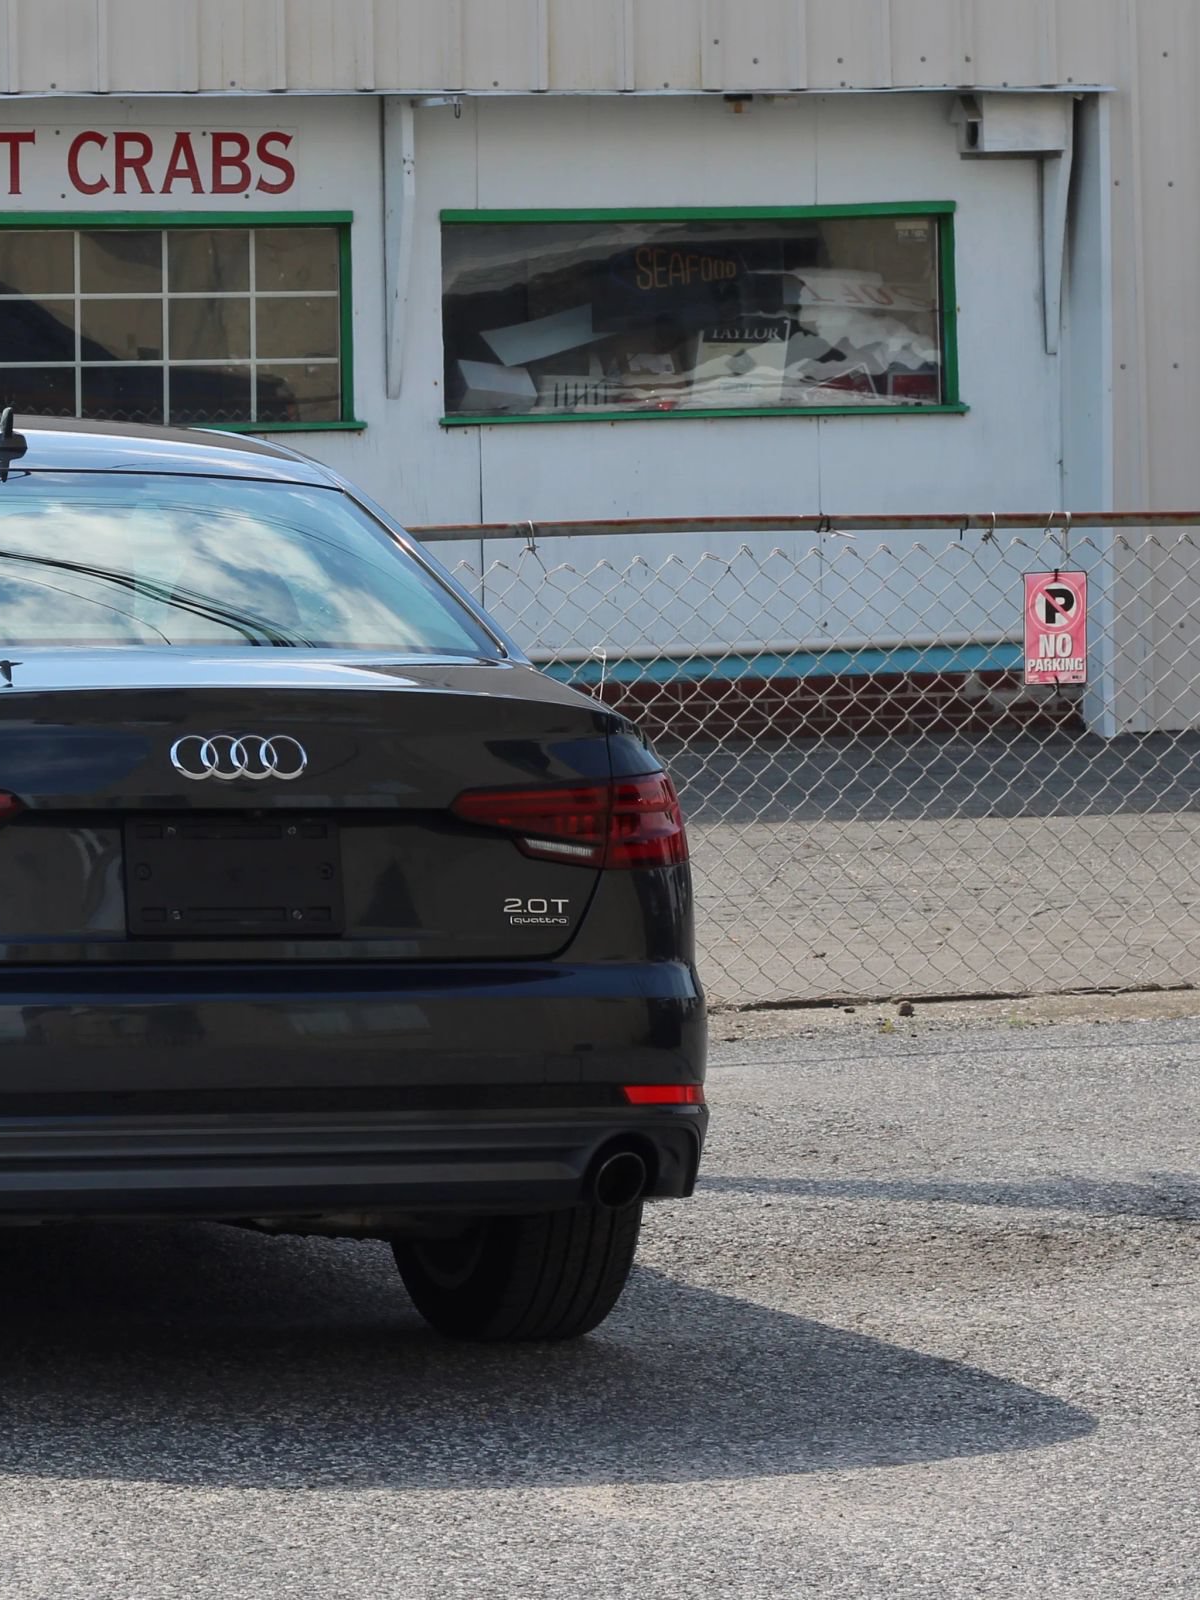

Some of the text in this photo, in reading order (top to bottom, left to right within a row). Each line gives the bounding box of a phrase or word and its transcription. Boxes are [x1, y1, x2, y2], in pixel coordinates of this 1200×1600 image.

[67, 130, 296, 195] CRABS
[635, 246, 737, 290] SEAFOOD
[1039, 633, 1073, 658] NO
[1027, 658, 1084, 672] PARKING
[503, 898, 569, 914] 2.0T
[513, 916, 567, 925] quattro
